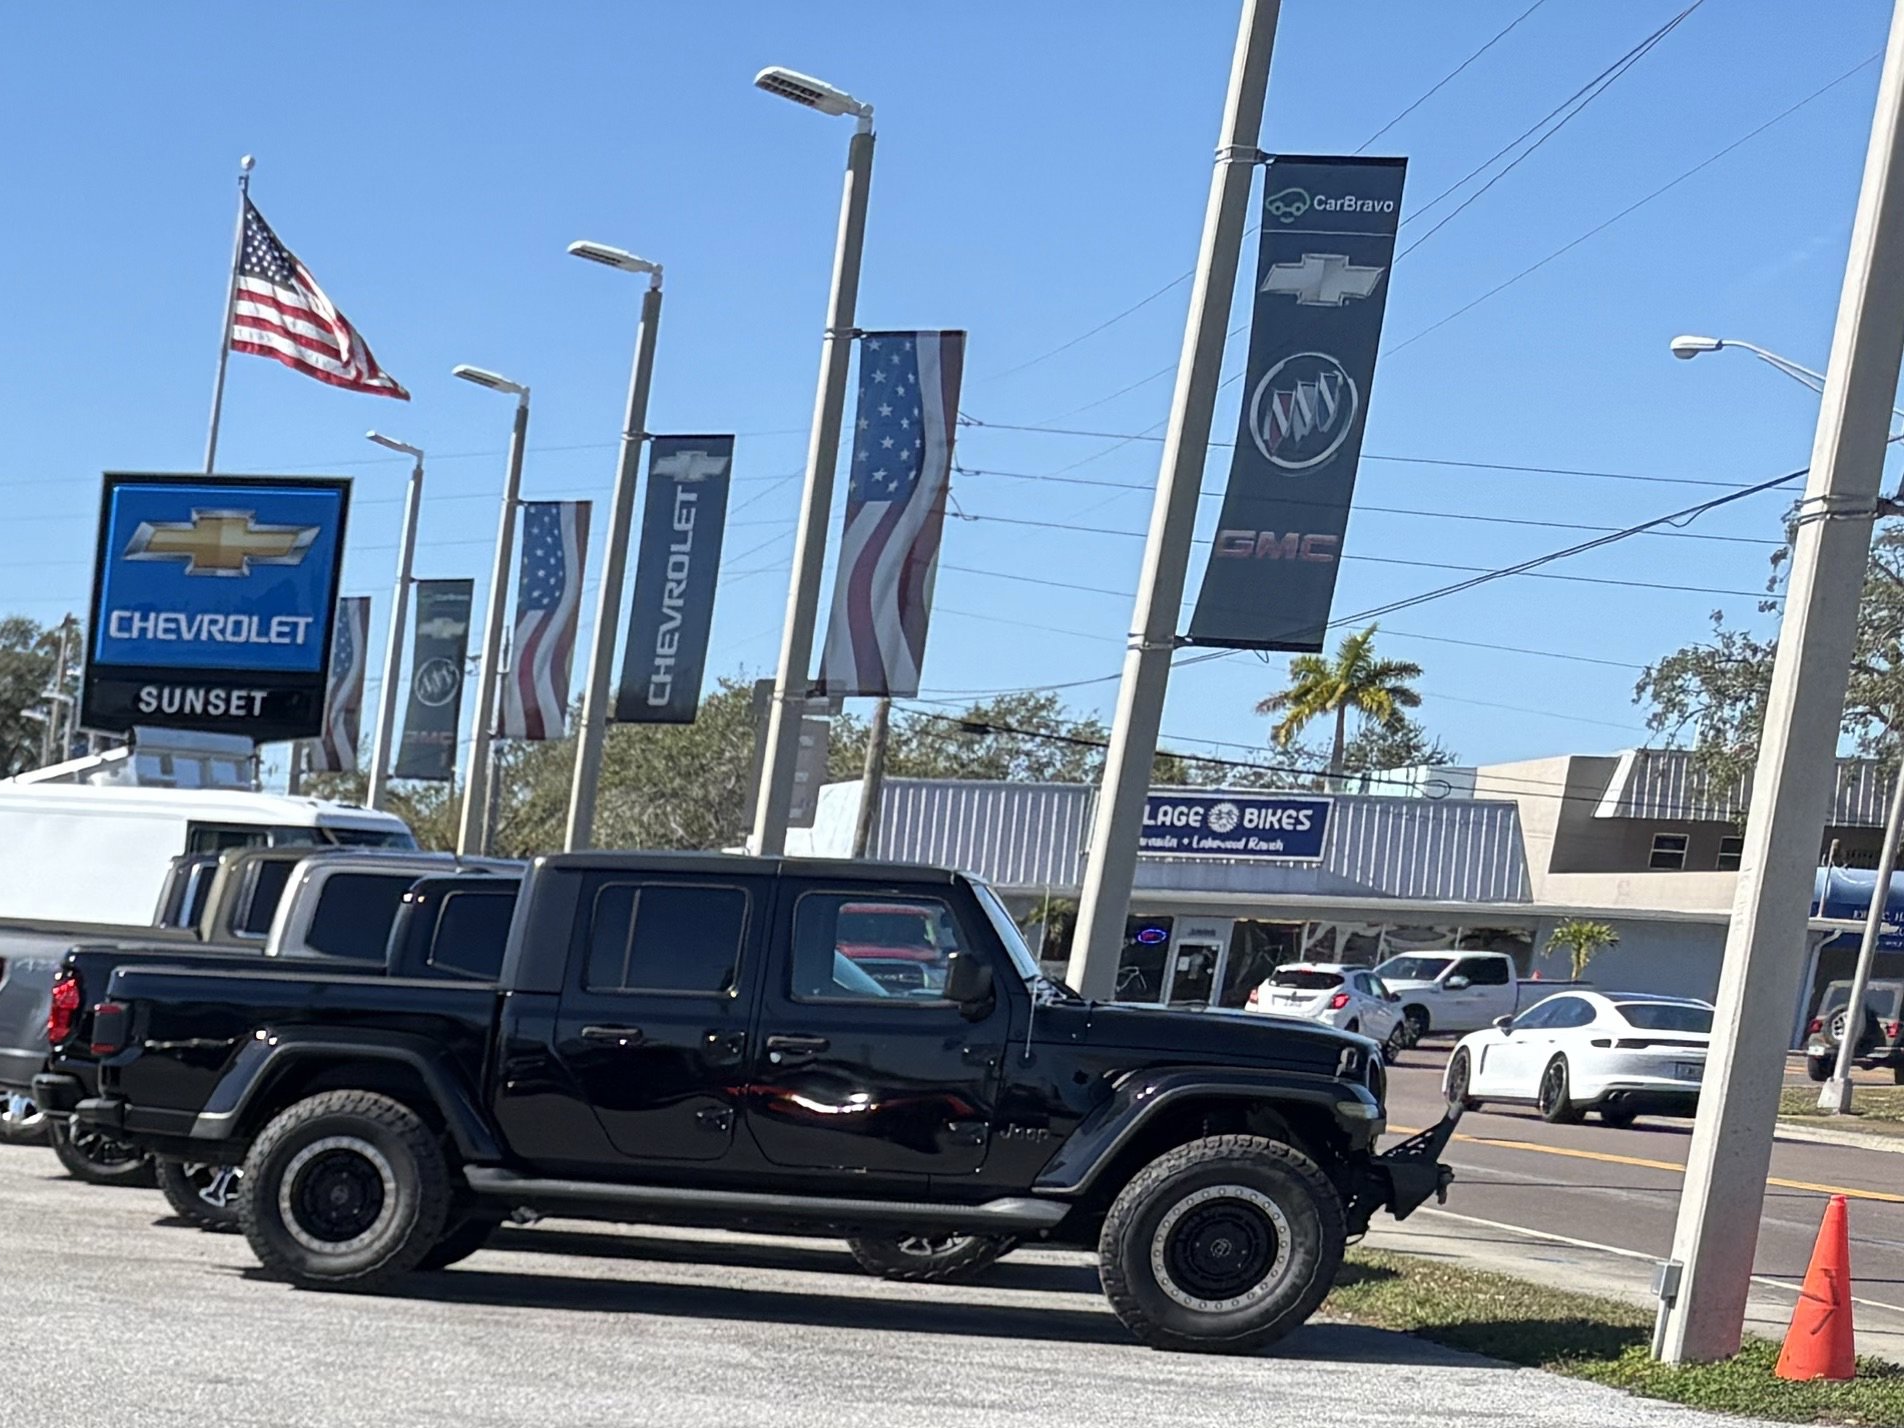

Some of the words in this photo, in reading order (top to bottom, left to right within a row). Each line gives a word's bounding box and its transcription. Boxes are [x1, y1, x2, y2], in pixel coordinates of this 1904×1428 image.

[1312, 193, 1395, 214] CarBravo
[1215, 529, 1340, 563] GMC
[646, 484, 699, 707] CHEVROLET
[108, 609, 314, 645] CHEVROLET
[138, 684, 268, 717] SUNSET
[1142, 804, 1205, 828] LAGE
[1243, 807, 1314, 832] BIKES
[999, 1123, 1049, 1144] Jeep
